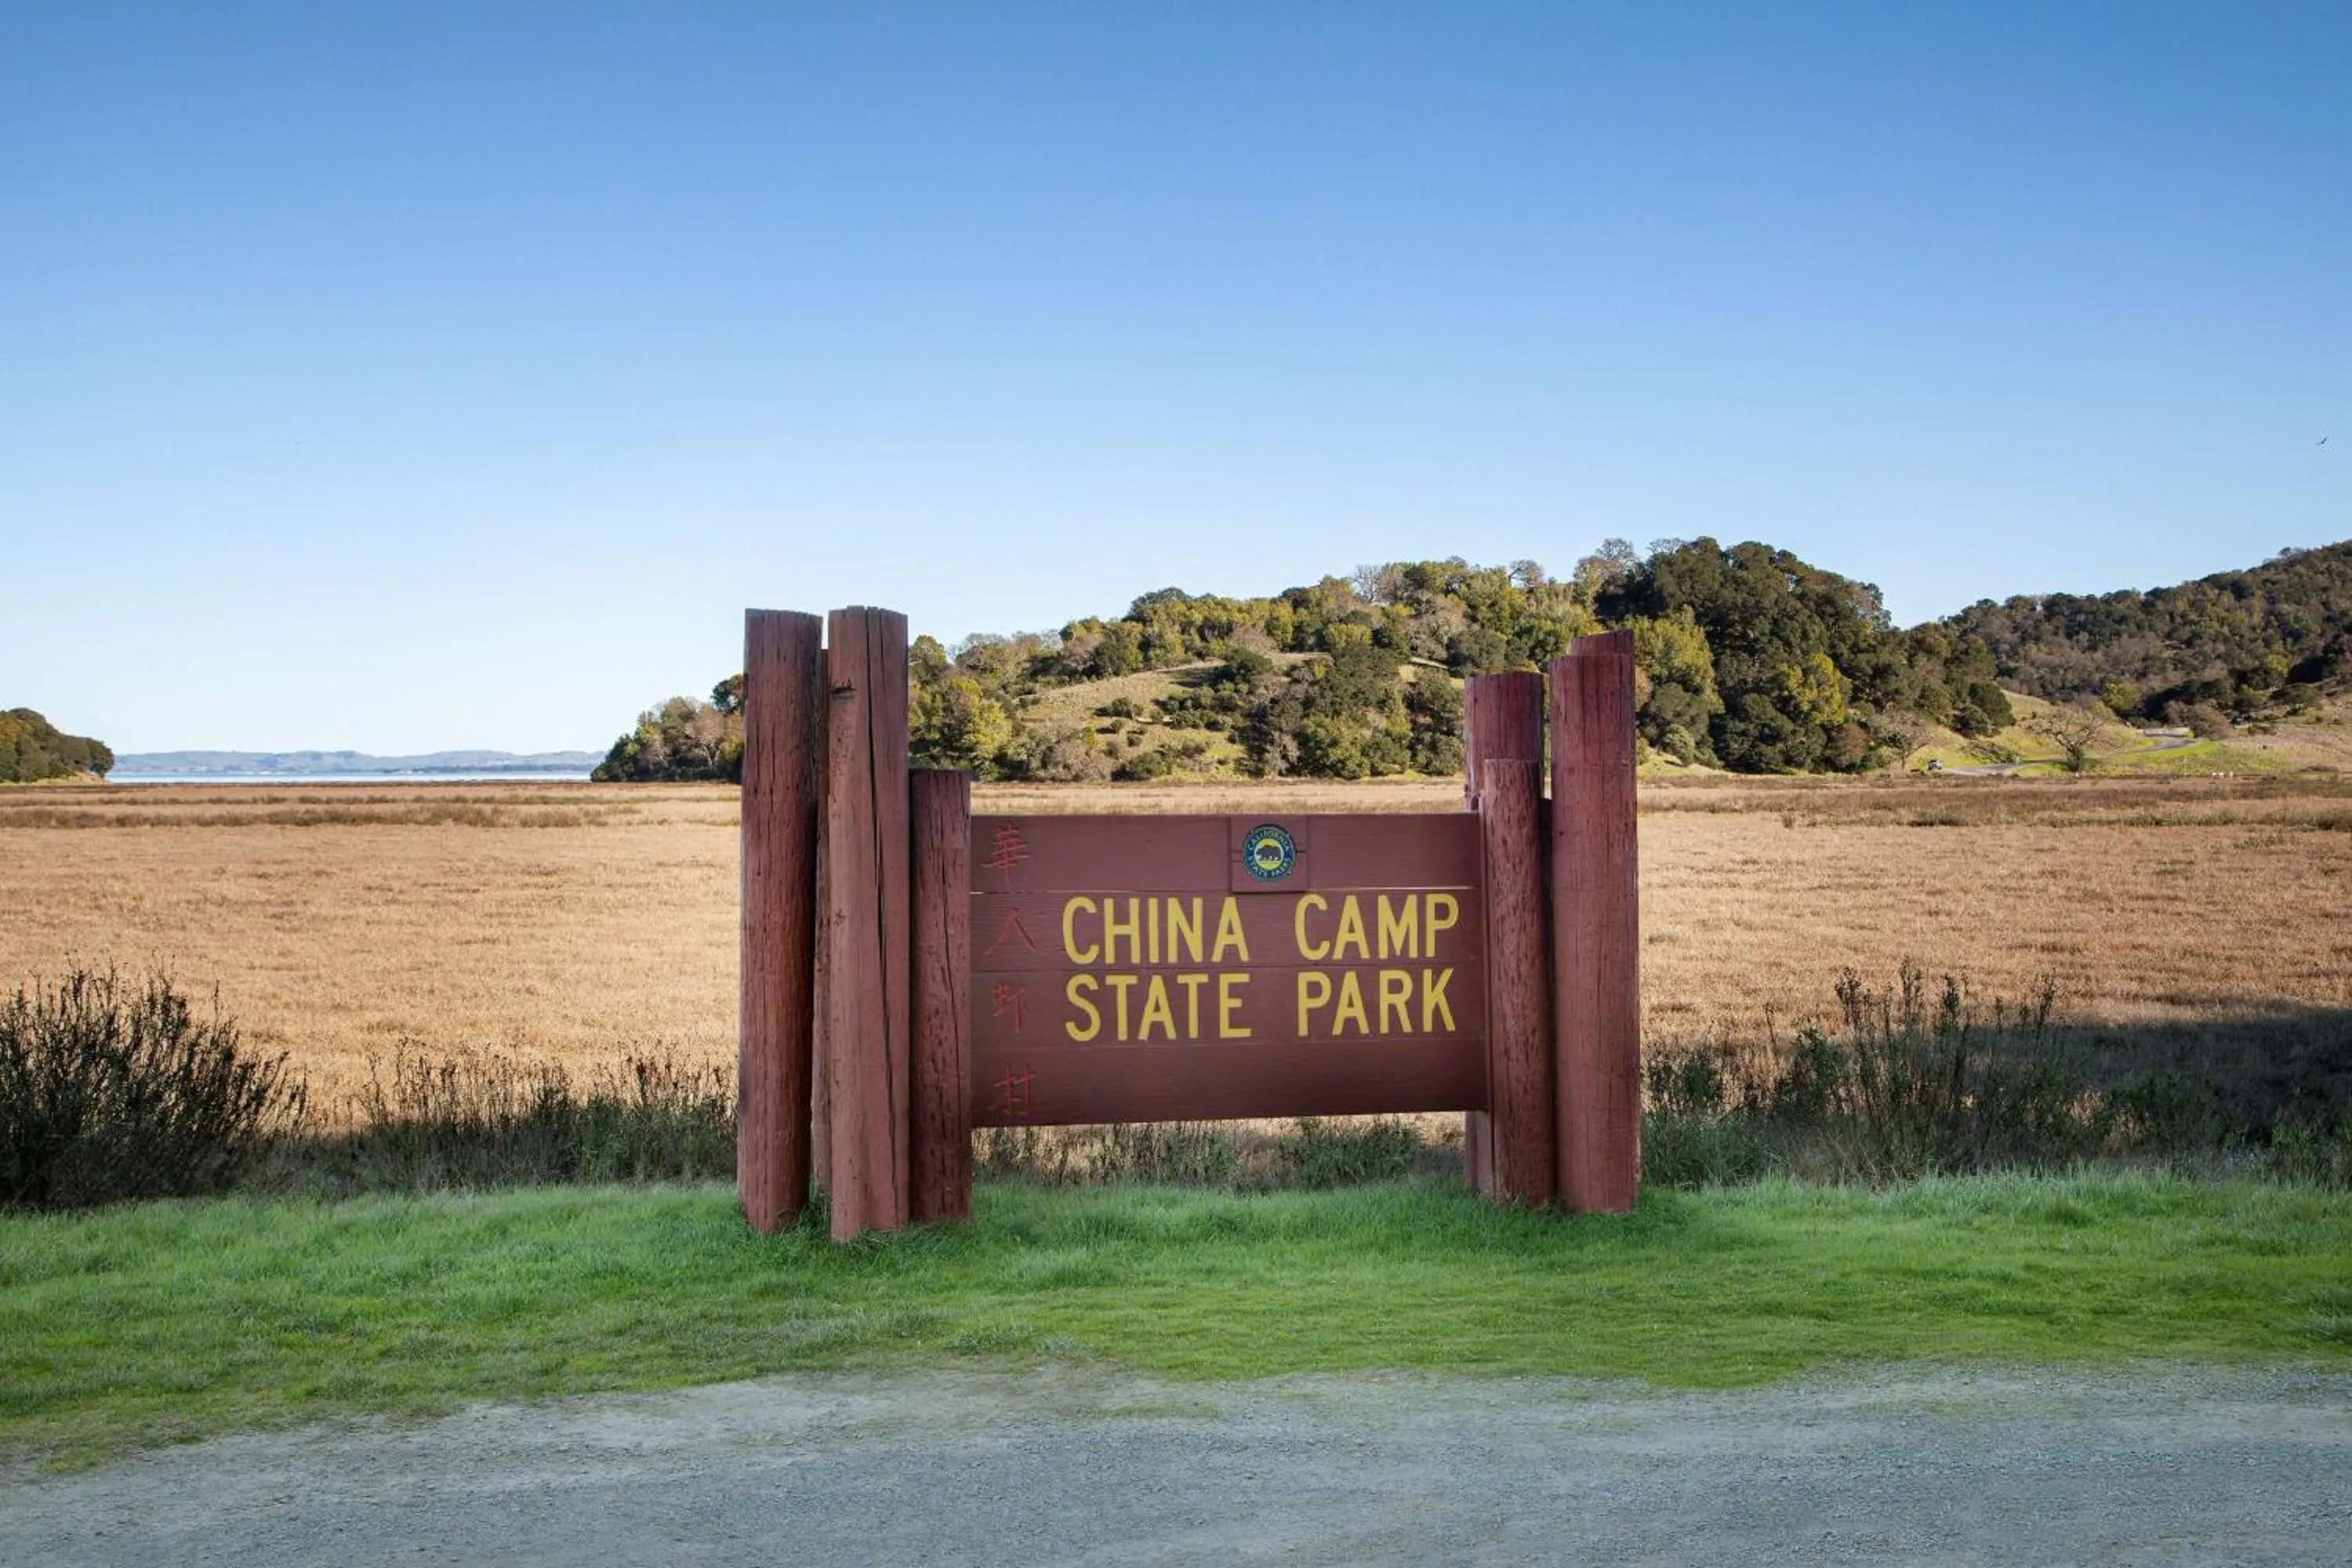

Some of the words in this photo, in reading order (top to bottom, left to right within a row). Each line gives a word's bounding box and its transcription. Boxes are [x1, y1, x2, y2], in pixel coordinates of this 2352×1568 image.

[1062, 895, 1250, 964] CHINA
[1294, 893, 1459, 961] CAMP
[1065, 972, 1252, 1042] STATE
[1298, 968, 1456, 1036] PARK
